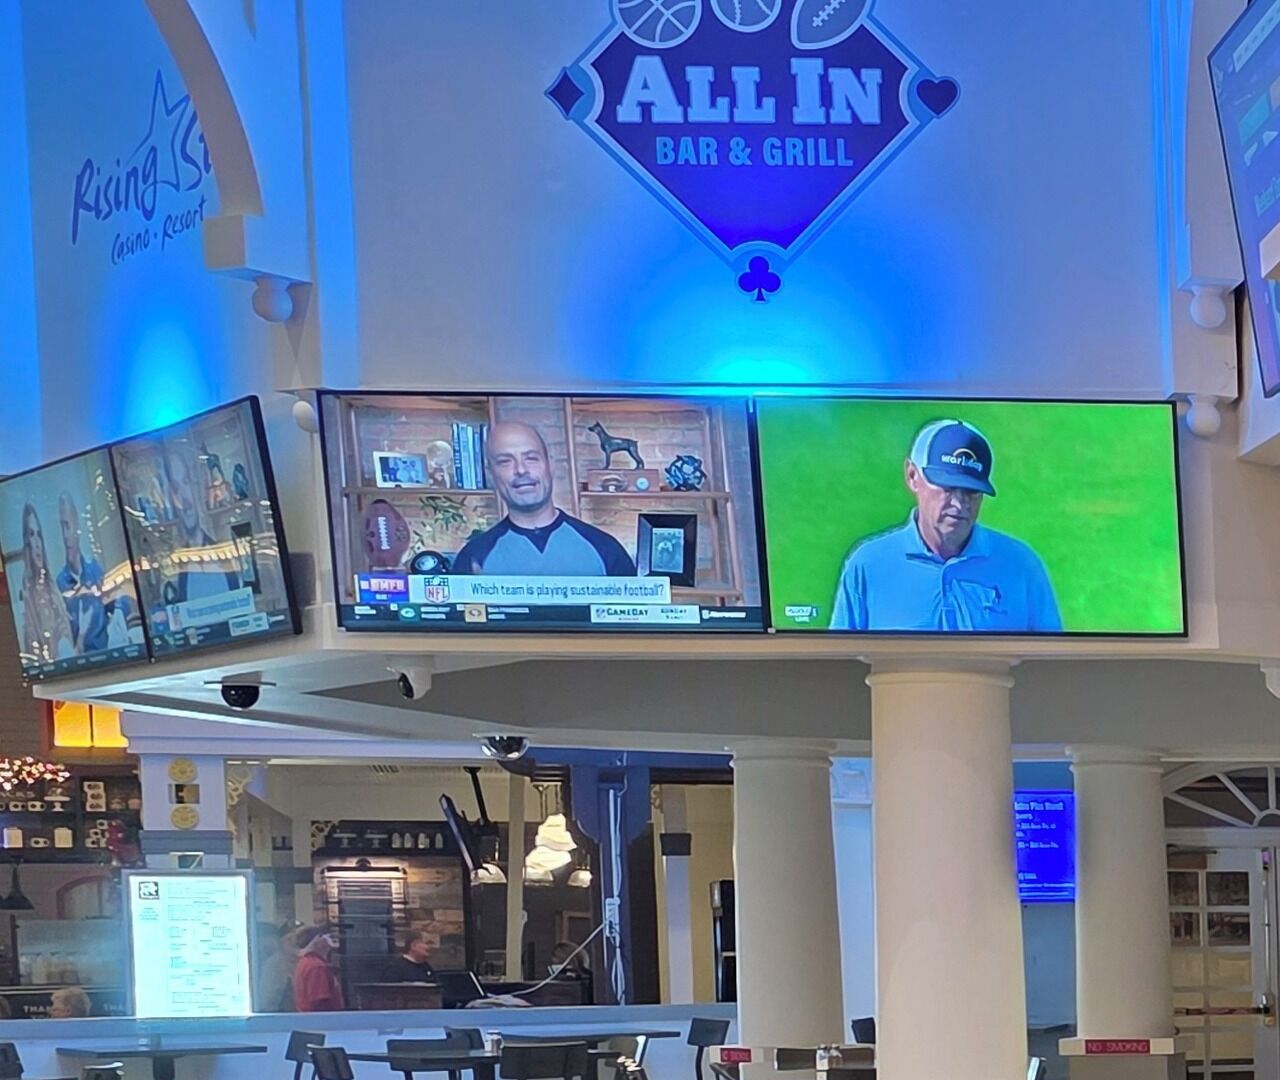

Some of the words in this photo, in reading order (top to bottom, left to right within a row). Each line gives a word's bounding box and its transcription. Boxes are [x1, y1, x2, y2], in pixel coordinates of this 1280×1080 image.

[616, 55, 776, 124] ALL
[790, 57, 881, 125] IN
[656, 136, 718, 165] BAR
[728, 139, 752, 166] &
[763, 138, 854, 167] GRILL
[72, 145, 158, 246] Rising
[180, 110, 212, 191] St
[112, 229, 149, 265] Casino
[162, 195, 207, 251] Resort
[427, 587, 449, 600] NFL
[471, 582, 499, 596] Which
[501, 584, 525, 596] team
[537, 583, 568, 599] playing
[570, 583, 622, 596] sustainable
[624, 583, 665, 597] football?
[1087, 1041, 1102, 1052] NO
[1106, 1041, 1148, 1052] SMOKING
